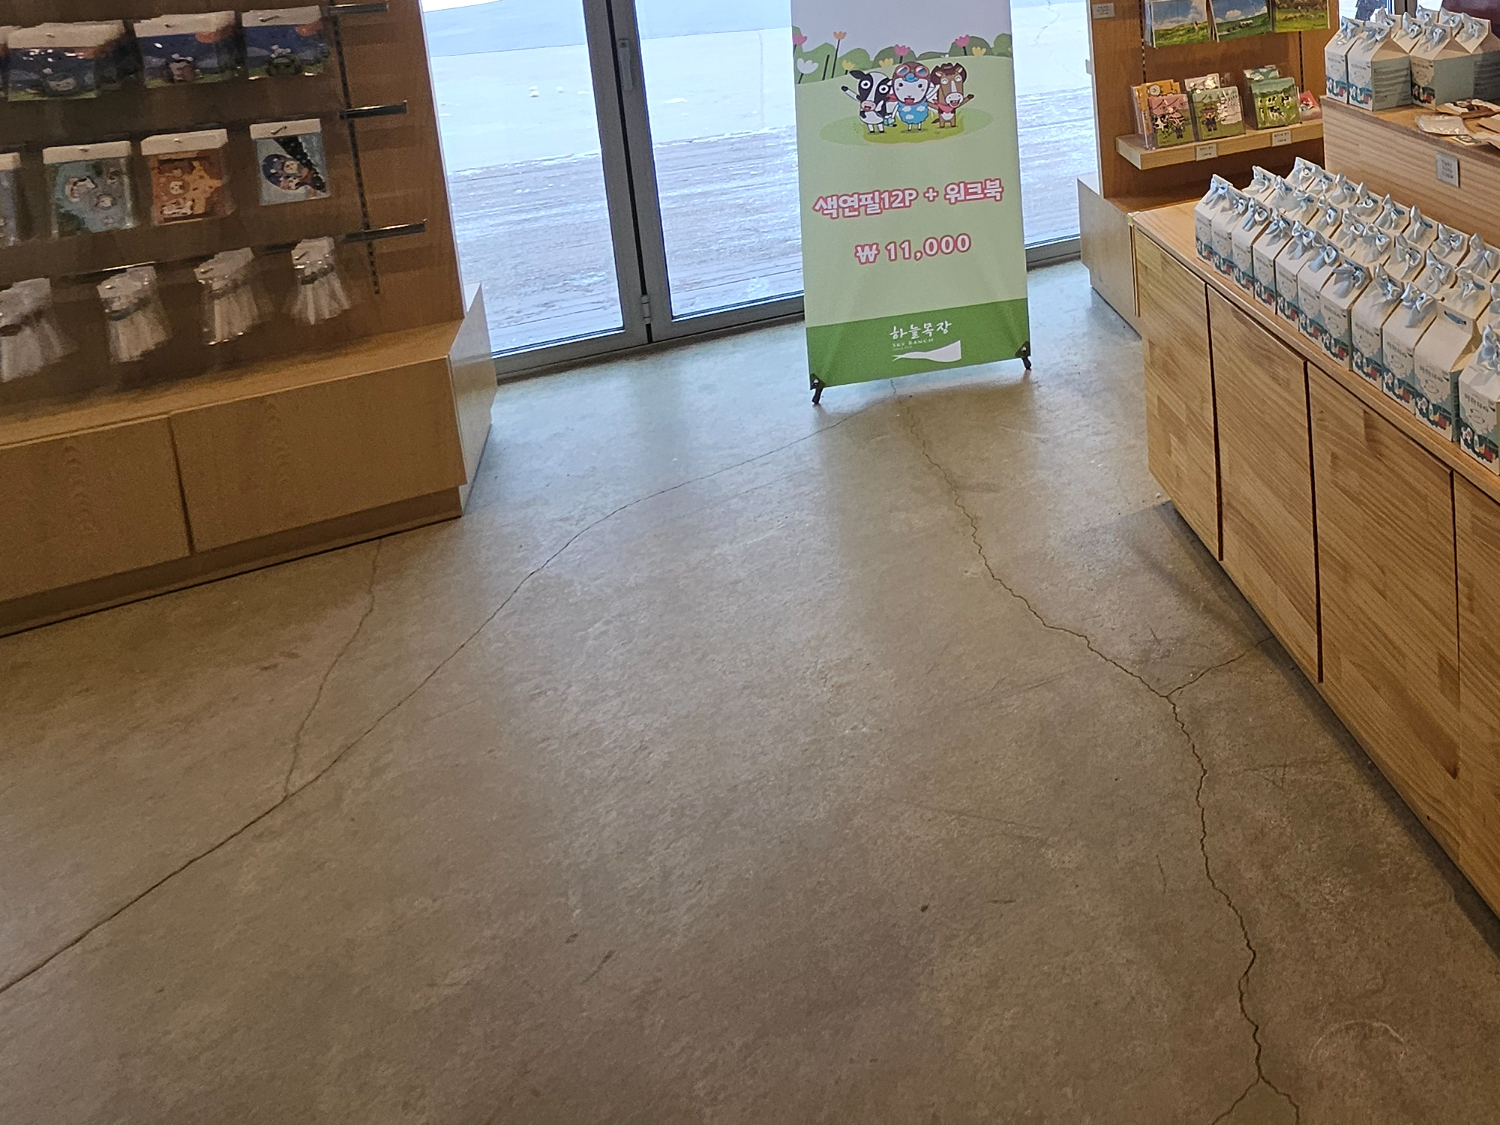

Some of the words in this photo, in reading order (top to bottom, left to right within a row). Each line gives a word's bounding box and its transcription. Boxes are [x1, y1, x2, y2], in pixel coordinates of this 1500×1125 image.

[812, 187, 919, 219] 색연필12P
[923, 187, 939, 204] +
[944, 178, 1004, 204] 워크북
[884, 233, 971, 262] 11,000
[889, 320, 952, 340] 하늘목장
